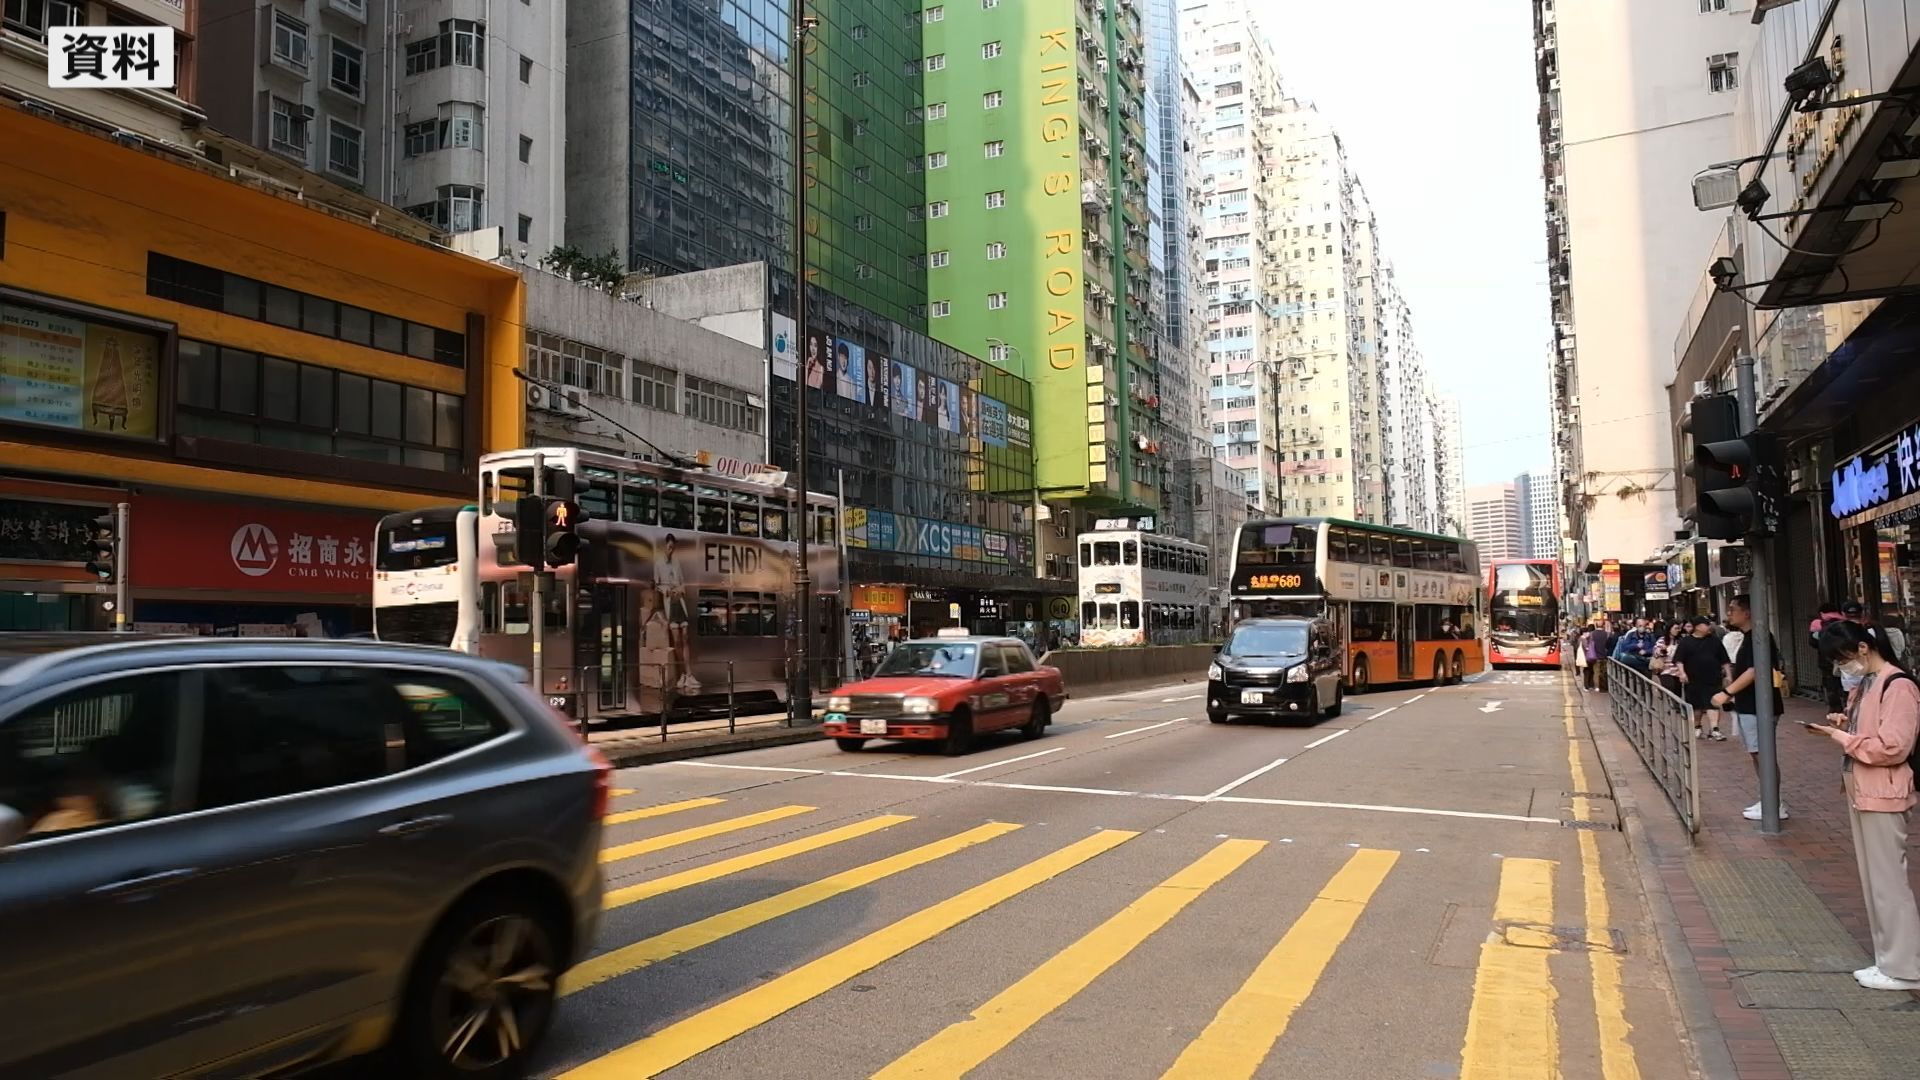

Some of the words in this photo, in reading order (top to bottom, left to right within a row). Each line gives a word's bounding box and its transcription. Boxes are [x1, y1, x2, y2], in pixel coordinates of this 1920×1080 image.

[1039, 29, 1071, 198] KING'S
[1045, 230, 1076, 372] ROAD
[1896, 423, 1920, 495] 快
[288, 532, 374, 568] 招商永
[918, 523, 951, 554] KCS
[288, 567, 318, 578] CMB
[324, 568, 359, 580] WING
[704, 543, 763, 575] FENDI
[1279, 575, 1301, 588] 680
[549, 697, 566, 706] 129
